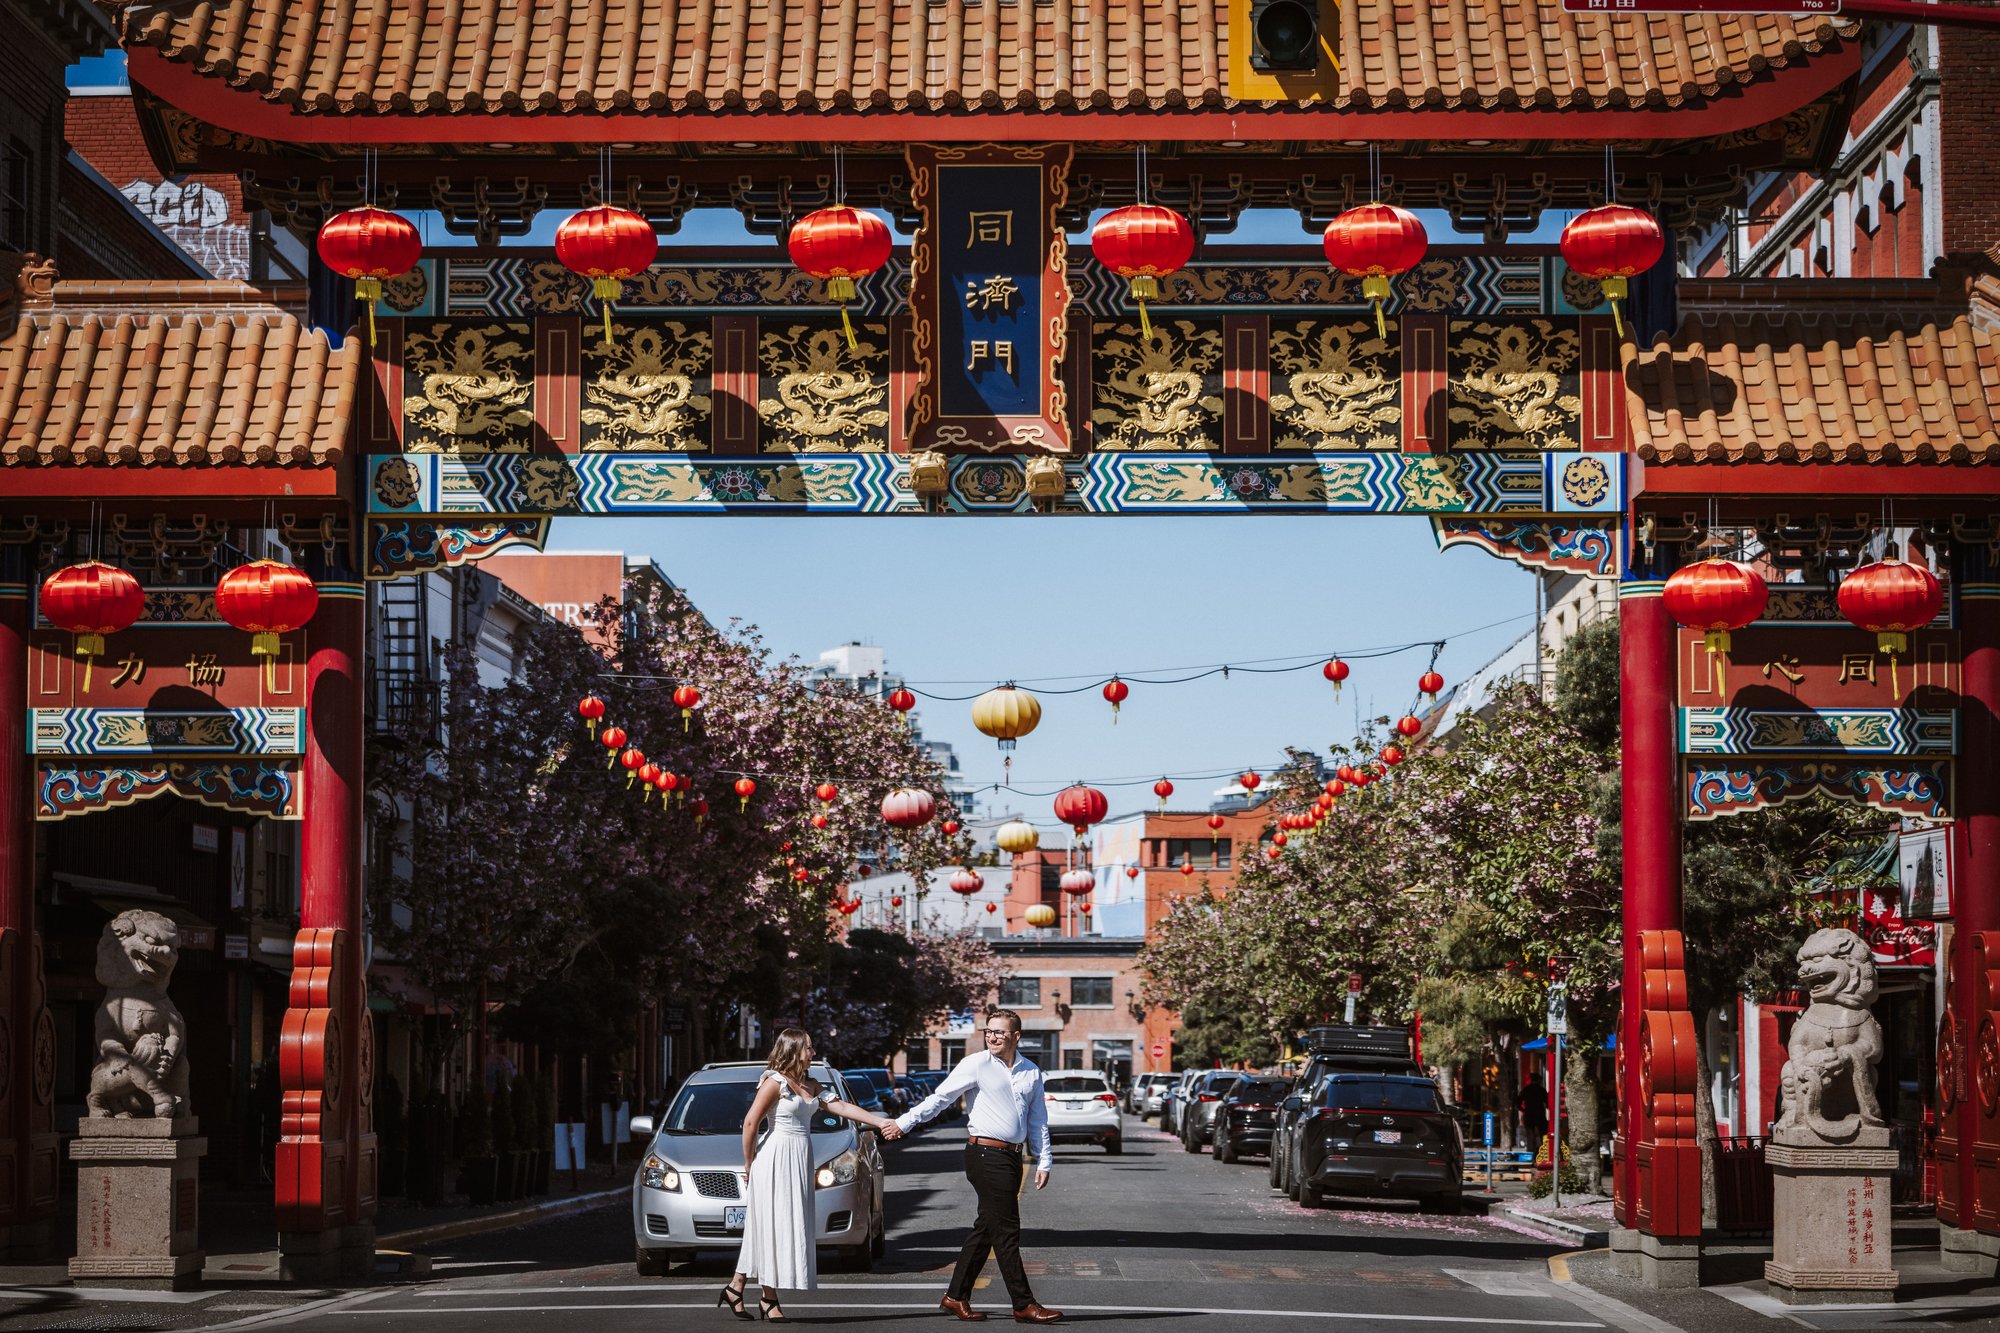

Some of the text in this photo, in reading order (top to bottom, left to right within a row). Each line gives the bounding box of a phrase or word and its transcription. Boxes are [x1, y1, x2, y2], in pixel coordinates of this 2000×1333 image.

[966, 209, 1018, 375] 同濟門
[1870, 926, 1933, 944] Coca-Cola
